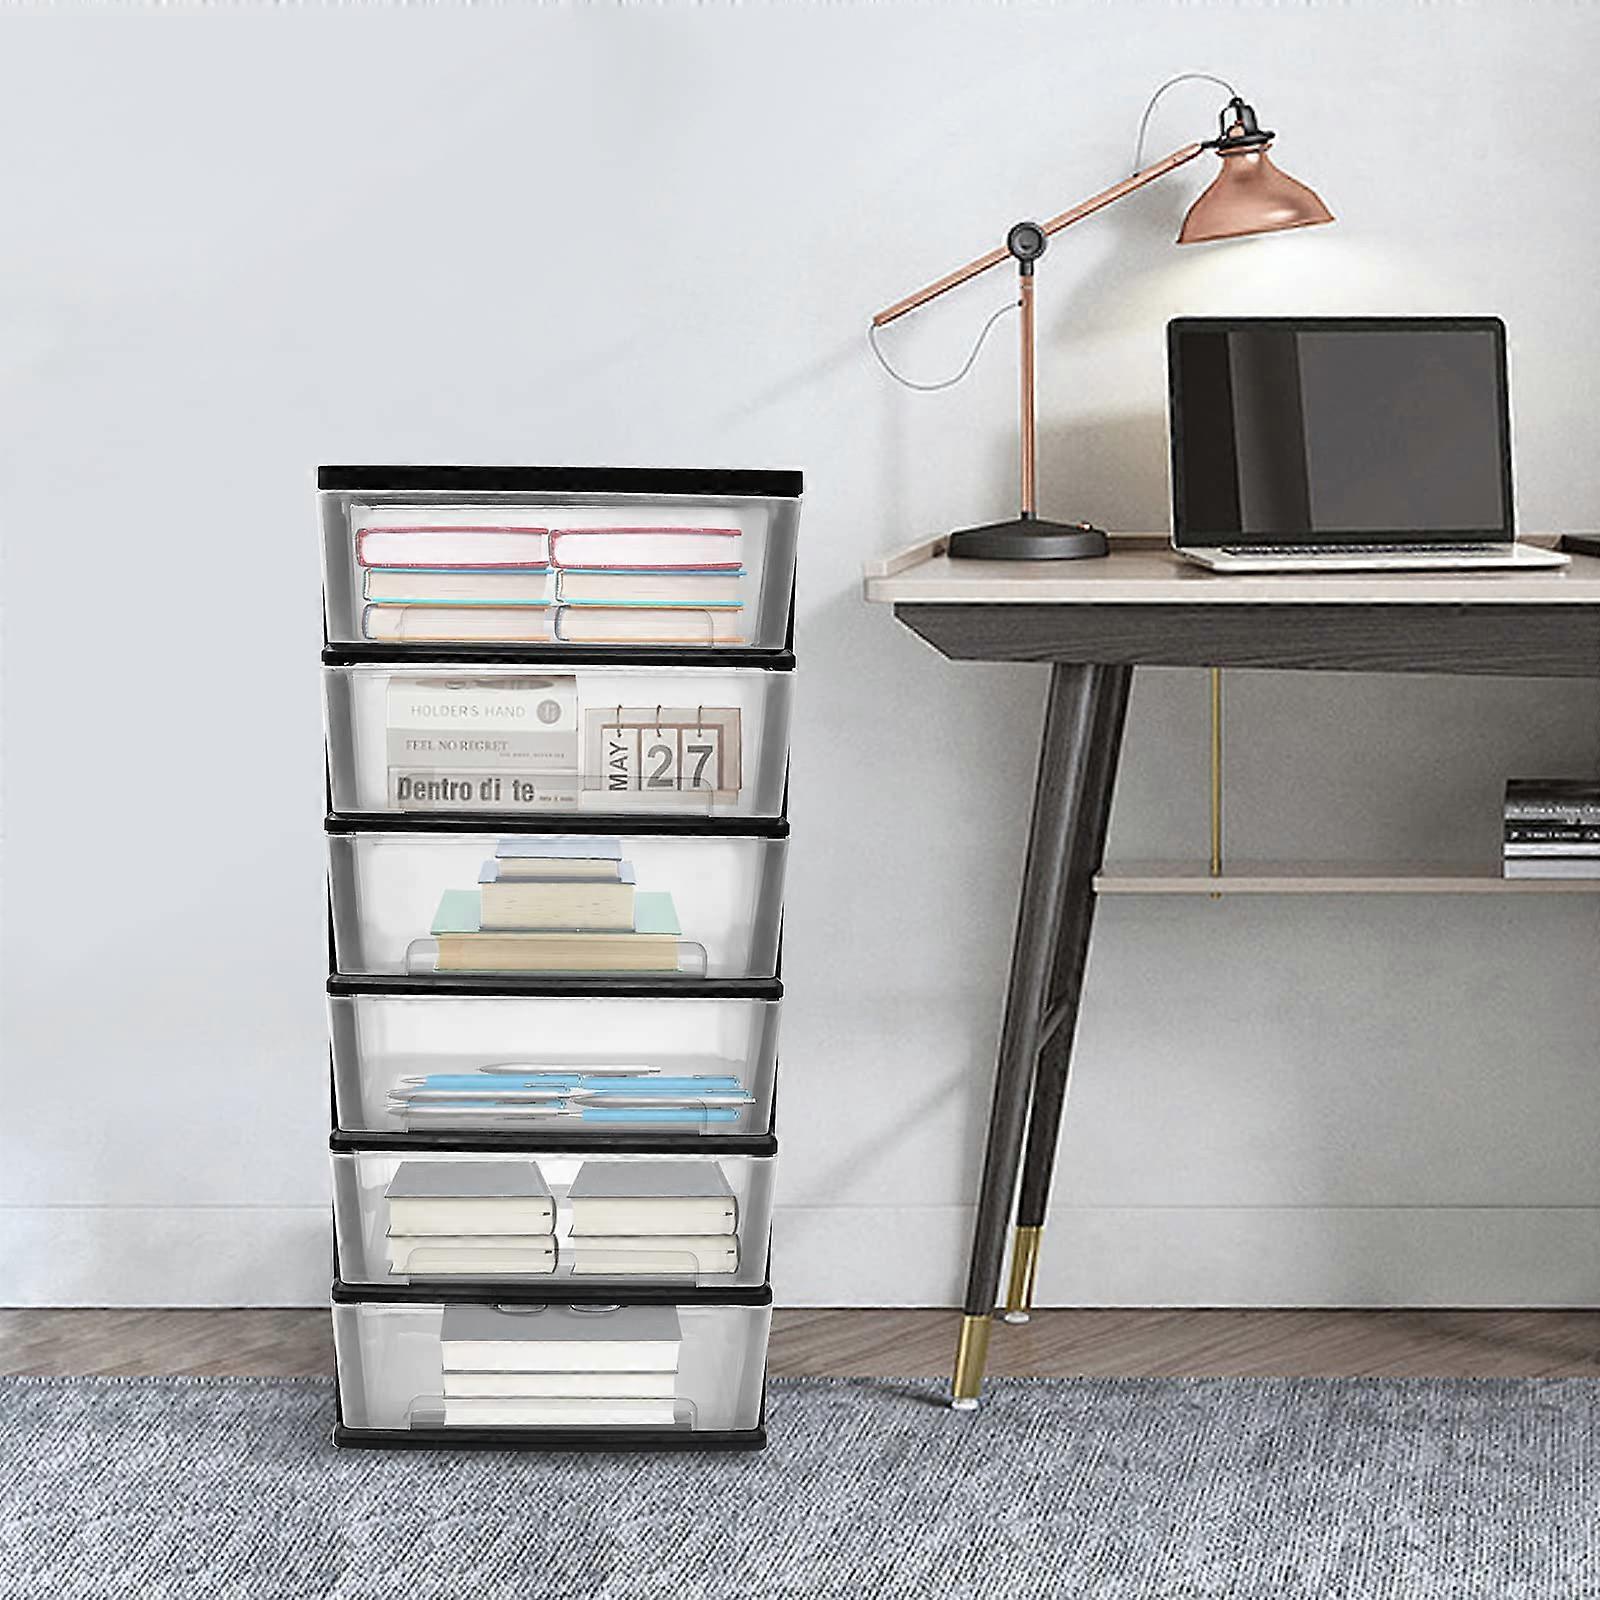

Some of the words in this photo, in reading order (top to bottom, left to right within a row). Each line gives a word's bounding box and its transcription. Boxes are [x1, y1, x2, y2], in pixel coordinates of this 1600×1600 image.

[485, 705, 526, 717] HAND
[406, 740, 433, 751] FEEL
[439, 740, 458, 751] NO
[460, 740, 508, 752] REGRET
[608, 741, 629, 791] MAY
[398, 777, 472, 801] Dentro
[480, 778, 501, 801] di
[513, 779, 535, 802] te
